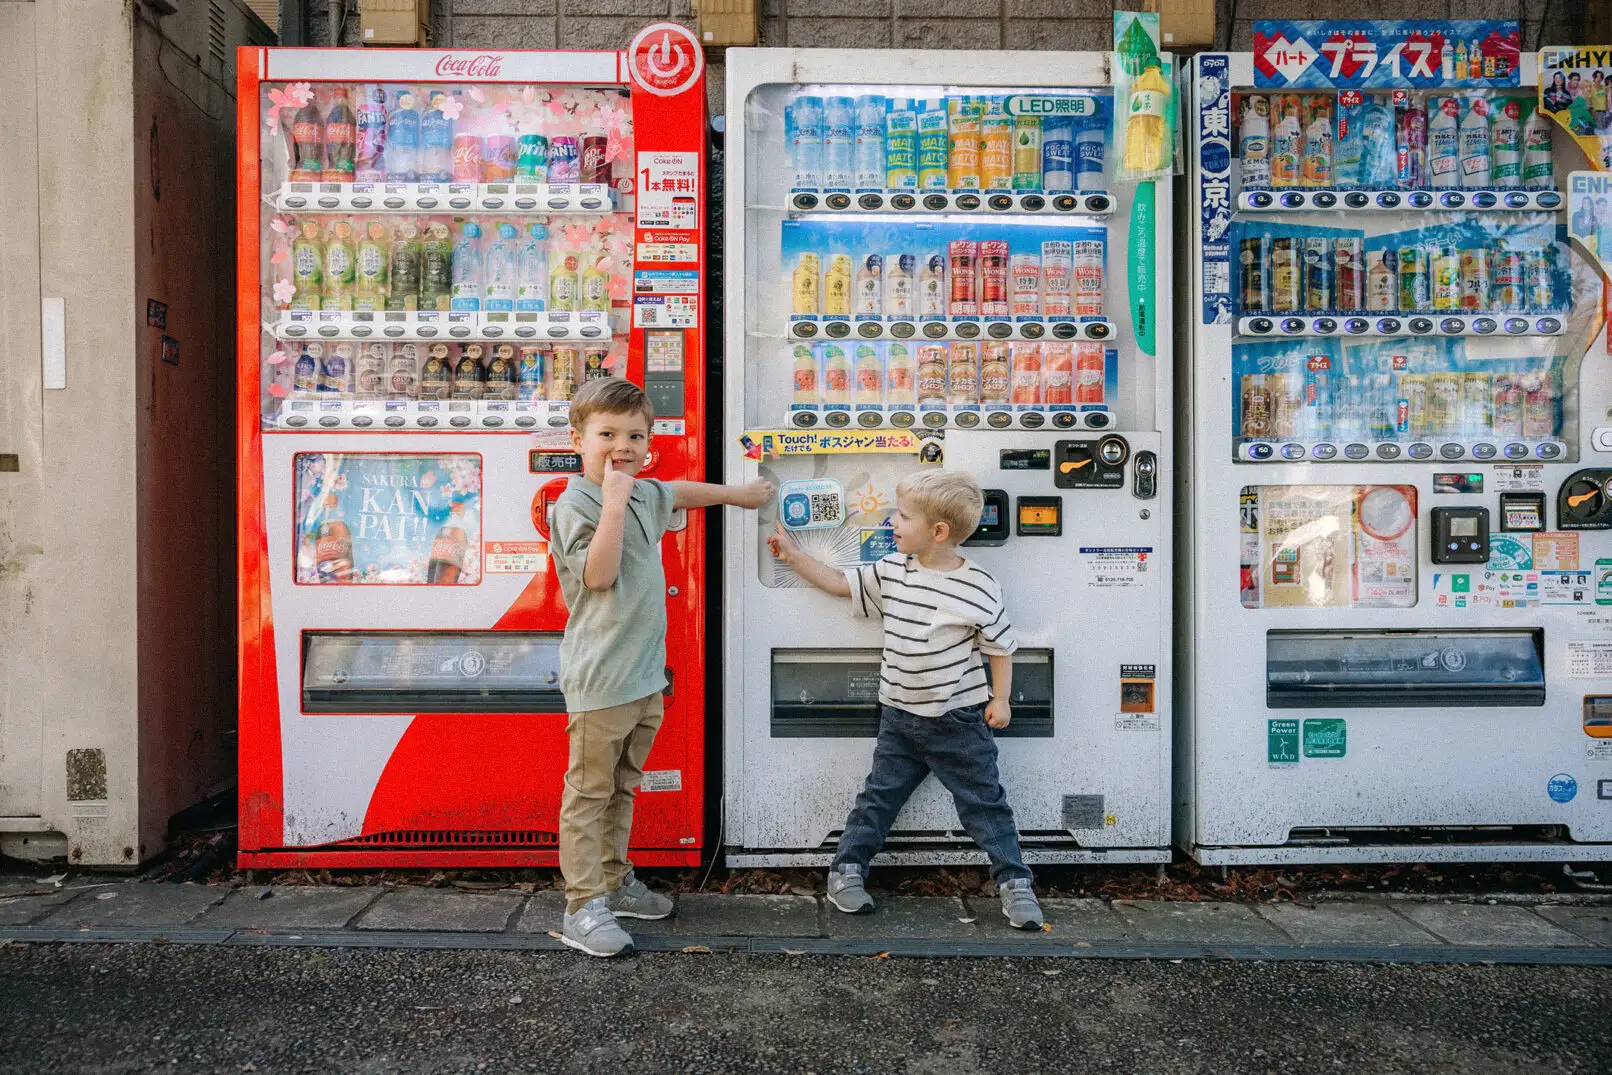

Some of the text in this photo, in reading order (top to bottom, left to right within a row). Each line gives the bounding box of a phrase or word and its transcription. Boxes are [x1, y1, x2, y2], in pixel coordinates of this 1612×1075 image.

[1203, 59, 1225, 67] DyDo
[1276, 51, 1307, 65] ハート
[1322, 39, 1434, 78] プライス
[435, 54, 504, 76] Coca-Cola
[1020, 99, 1085, 113] LED照明
[1202, 107, 1229, 137] 東
[519, 140, 548, 158] prit
[892, 137, 915, 148] MAT
[922, 137, 947, 148] MATC
[954, 139, 978, 149] MAT
[987, 140, 1009, 150] MAT
[1080, 144, 1104, 152] POCA
[640, 167, 695, 193] 1本無料!
[1202, 179, 1230, 208] 京
[778, 433, 817, 444] Touch!
[819, 436, 914, 448] ボスジャン当たる!
[537, 455, 577, 468] 販売中
[362, 475, 418, 488] SAKURA
[360, 487, 433, 516] KAN
[356, 514, 429, 543] PAI!!
